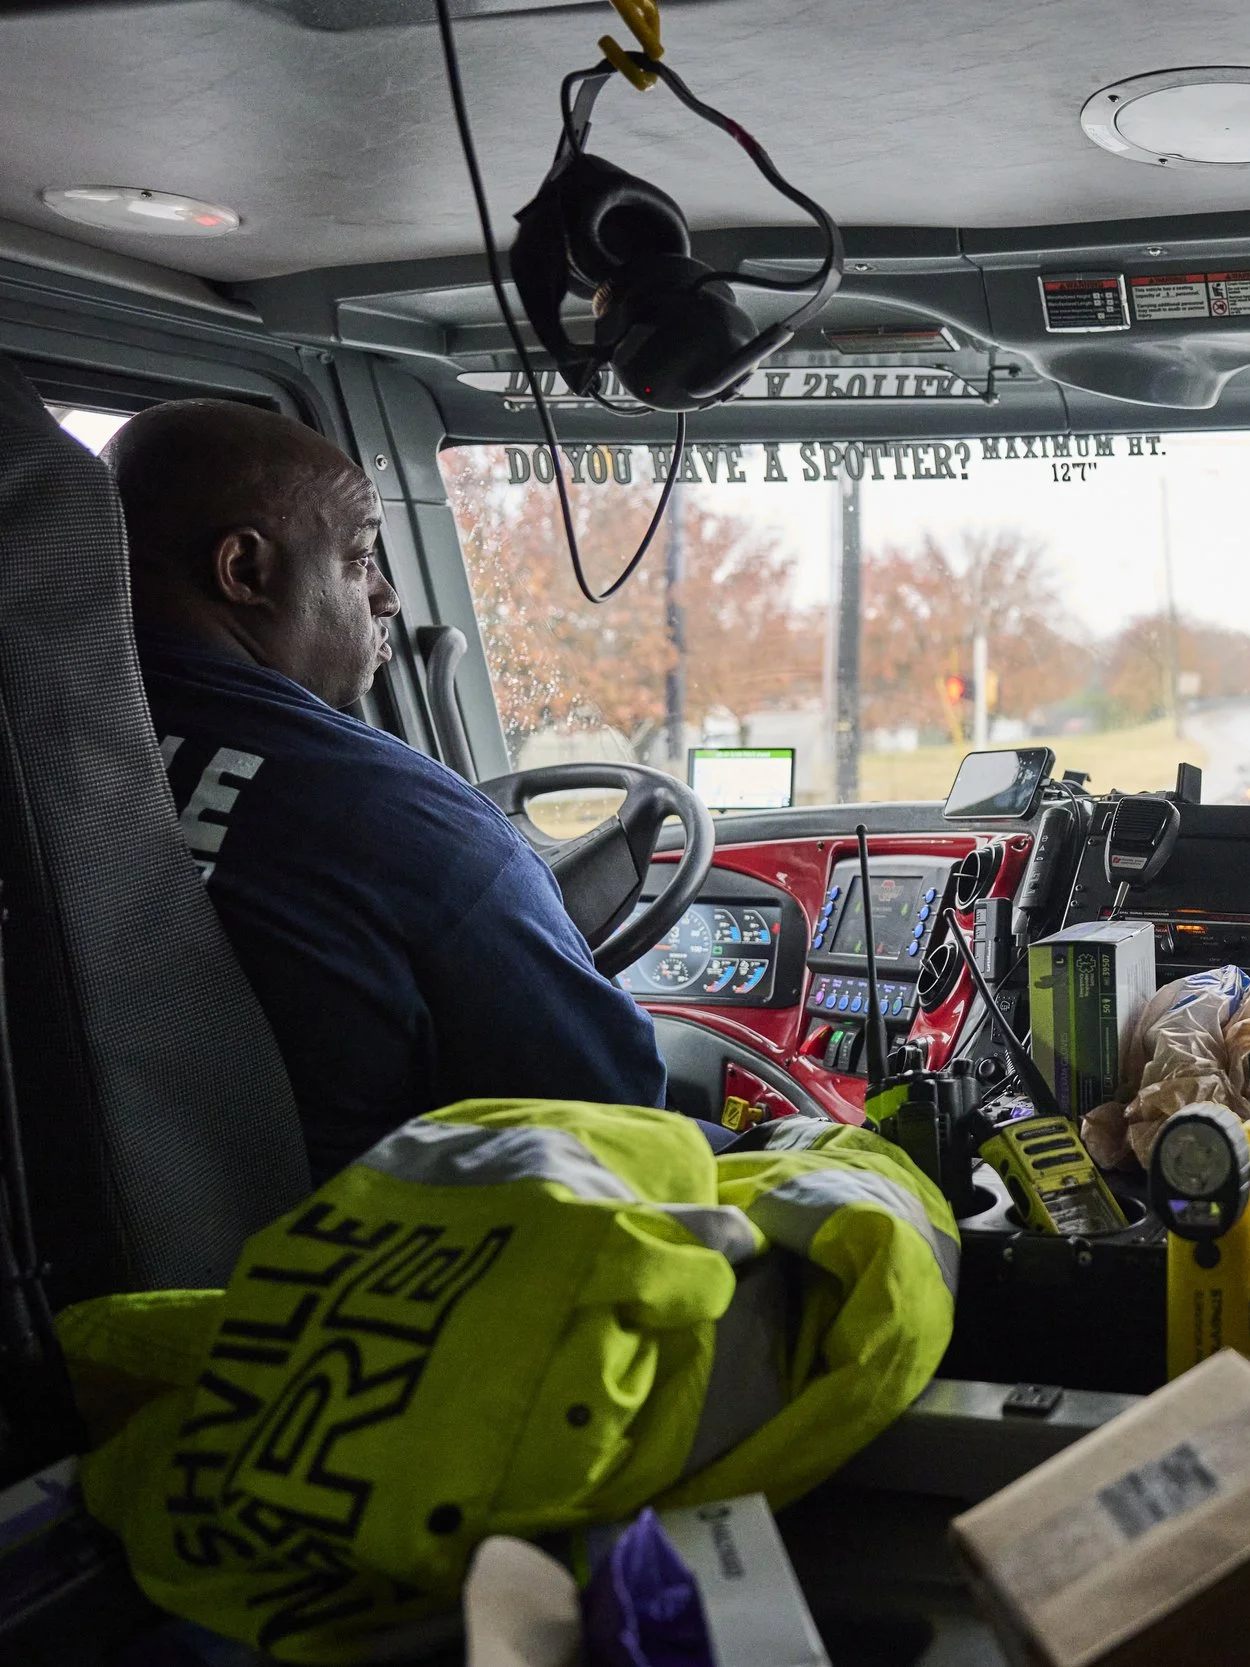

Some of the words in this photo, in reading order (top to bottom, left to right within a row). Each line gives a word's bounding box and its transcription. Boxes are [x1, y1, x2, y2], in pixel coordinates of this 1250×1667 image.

[979, 436, 1116, 460] MAXIMUM
[1126, 435, 1167, 456] HT.
[506, 446, 555, 485] DO
[557, 446, 634, 485] YOU
[651, 446, 747, 485] HAVE
[764, 445, 789, 483] A
[800, 441, 971, 482] SPOTTER?
[1055, 957, 1065, 965] L
[1101, 954, 1111, 977] 39507
[1102, 1004, 1111, 1014] 50
